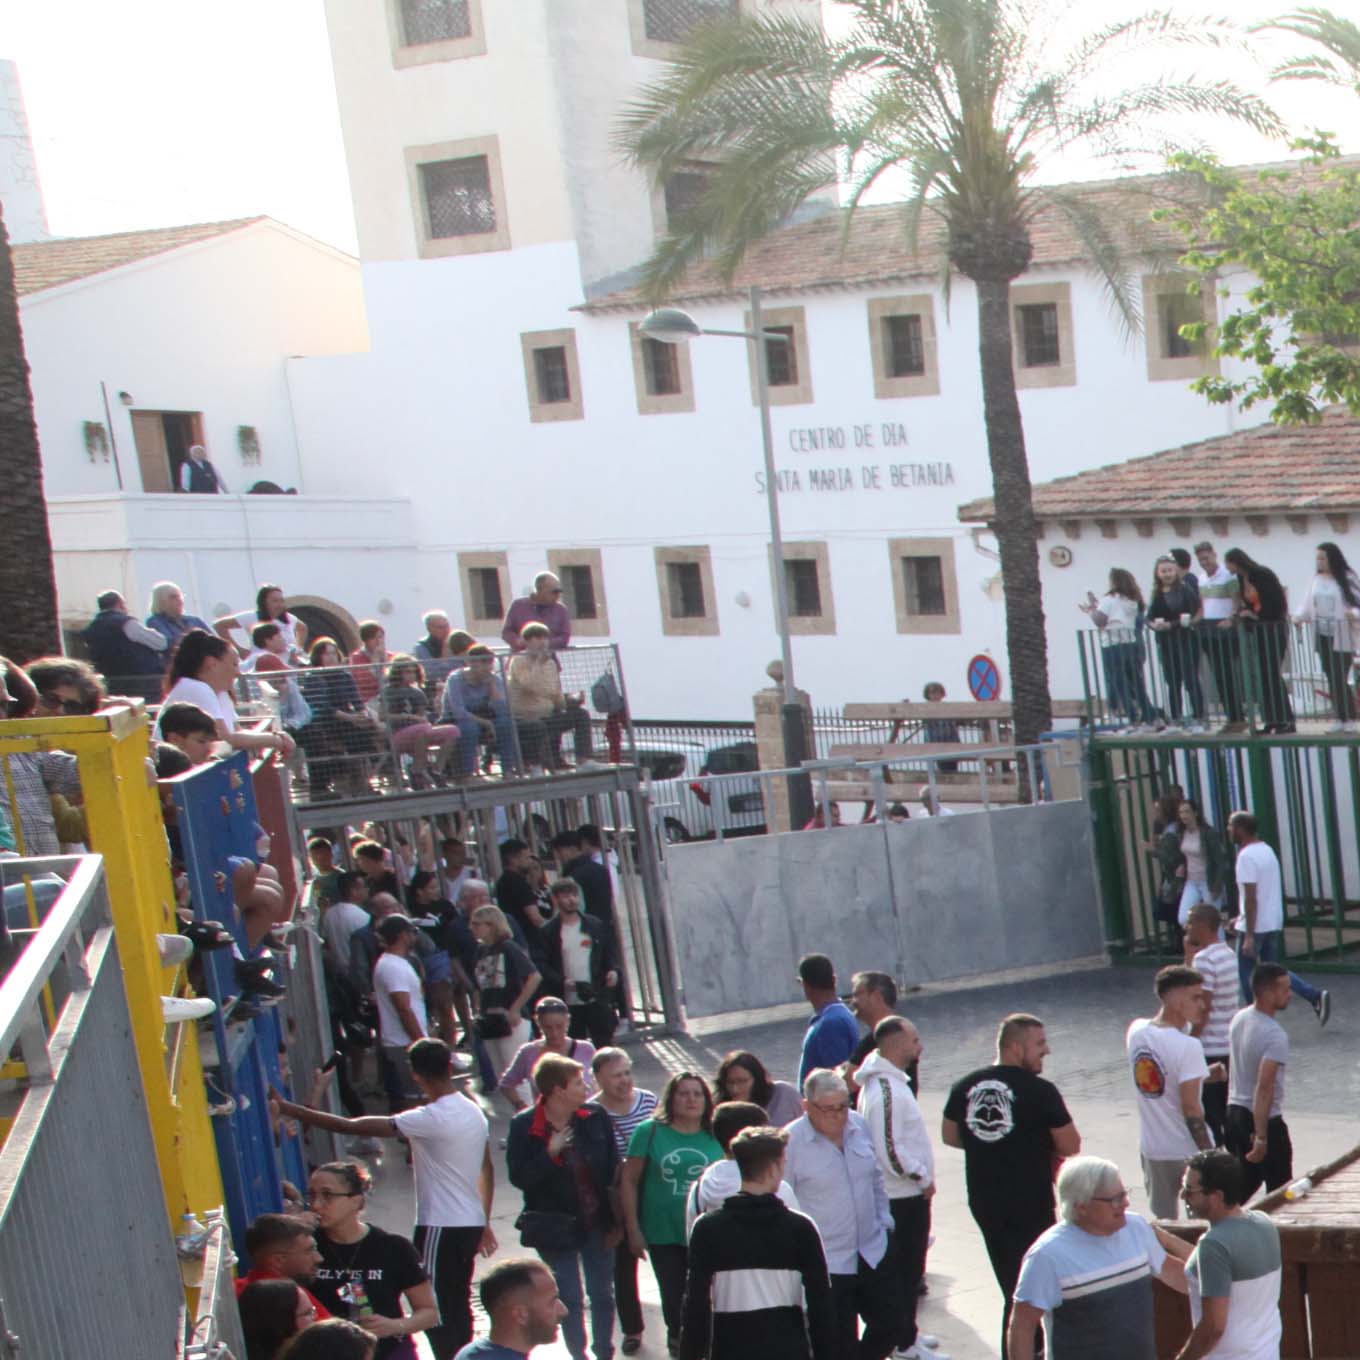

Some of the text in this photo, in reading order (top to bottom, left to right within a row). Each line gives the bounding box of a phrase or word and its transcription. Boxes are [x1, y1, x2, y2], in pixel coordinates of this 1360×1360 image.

[789, 422, 908, 453] CENTRO DE DIA
[754, 462, 955, 494] SNTA MARIA DE BETANIA
[367, 1268, 383, 1280] IN
